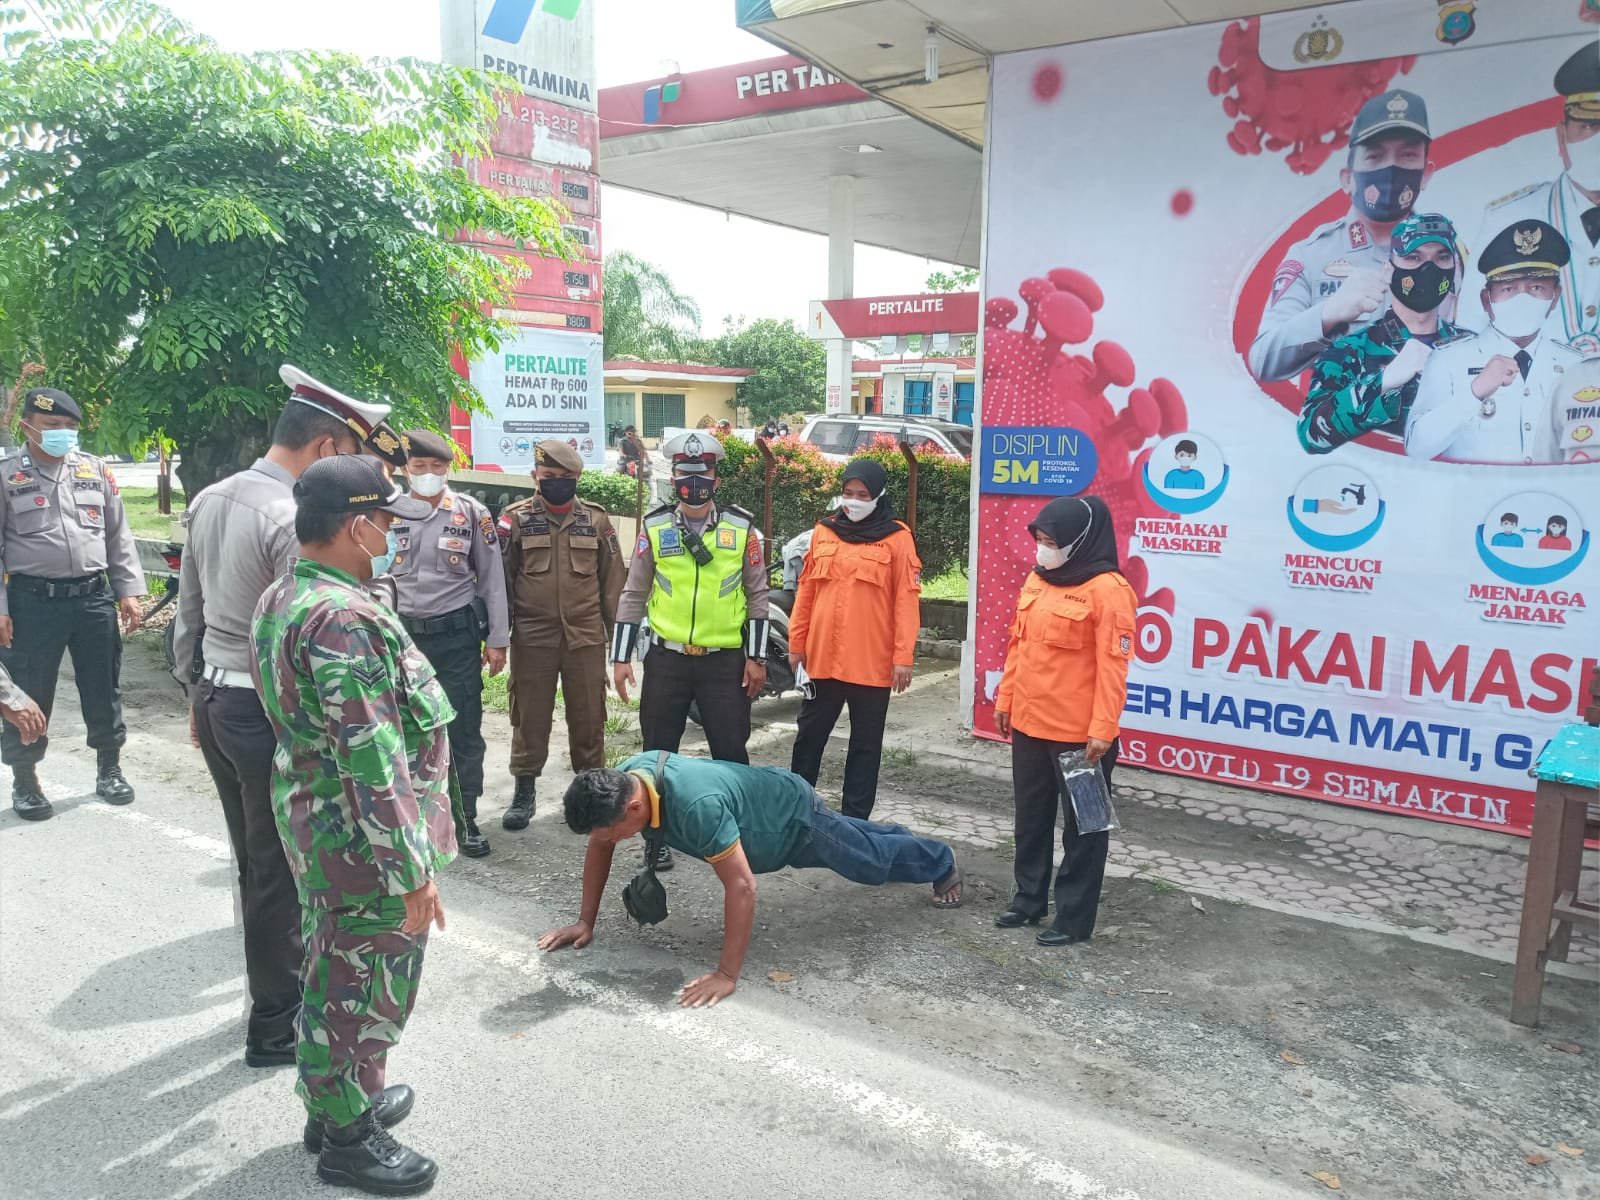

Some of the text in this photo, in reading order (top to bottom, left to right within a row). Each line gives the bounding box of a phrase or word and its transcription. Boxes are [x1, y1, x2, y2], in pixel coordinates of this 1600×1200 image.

[483, 54, 591, 102] PERTAMINA
[869, 299, 944, 315] PERTALITE
[815, 311, 822, 329] 1
[504, 353, 587, 375] PERTALITE
[504, 376, 588, 393] HEMAT Rp 600
[505, 393, 587, 410] ADA DI SINI
[992, 433, 1078, 456] DISIPLIN
[992, 459, 1039, 485] 5M
[74, 482, 101, 490] POLRI
[443, 526, 471, 537] POLRI
[1138, 520, 1227, 538] MEMAKAI
[1142, 536, 1221, 553] MASKER
[1285, 554, 1382, 574] MENCUCI
[1289, 571, 1374, 590] TANGAN
[1469, 584, 1586, 607] MENJAGA
[1484, 604, 1566, 624] JARAK
[1191, 618, 1386, 691] PAKAI
[1180, 690, 1340, 743] HARGA
[1349, 713, 1481, 771] MATI,
[1158, 745, 1260, 782] COVID
[1322, 771, 1510, 824] SEMAKIN
